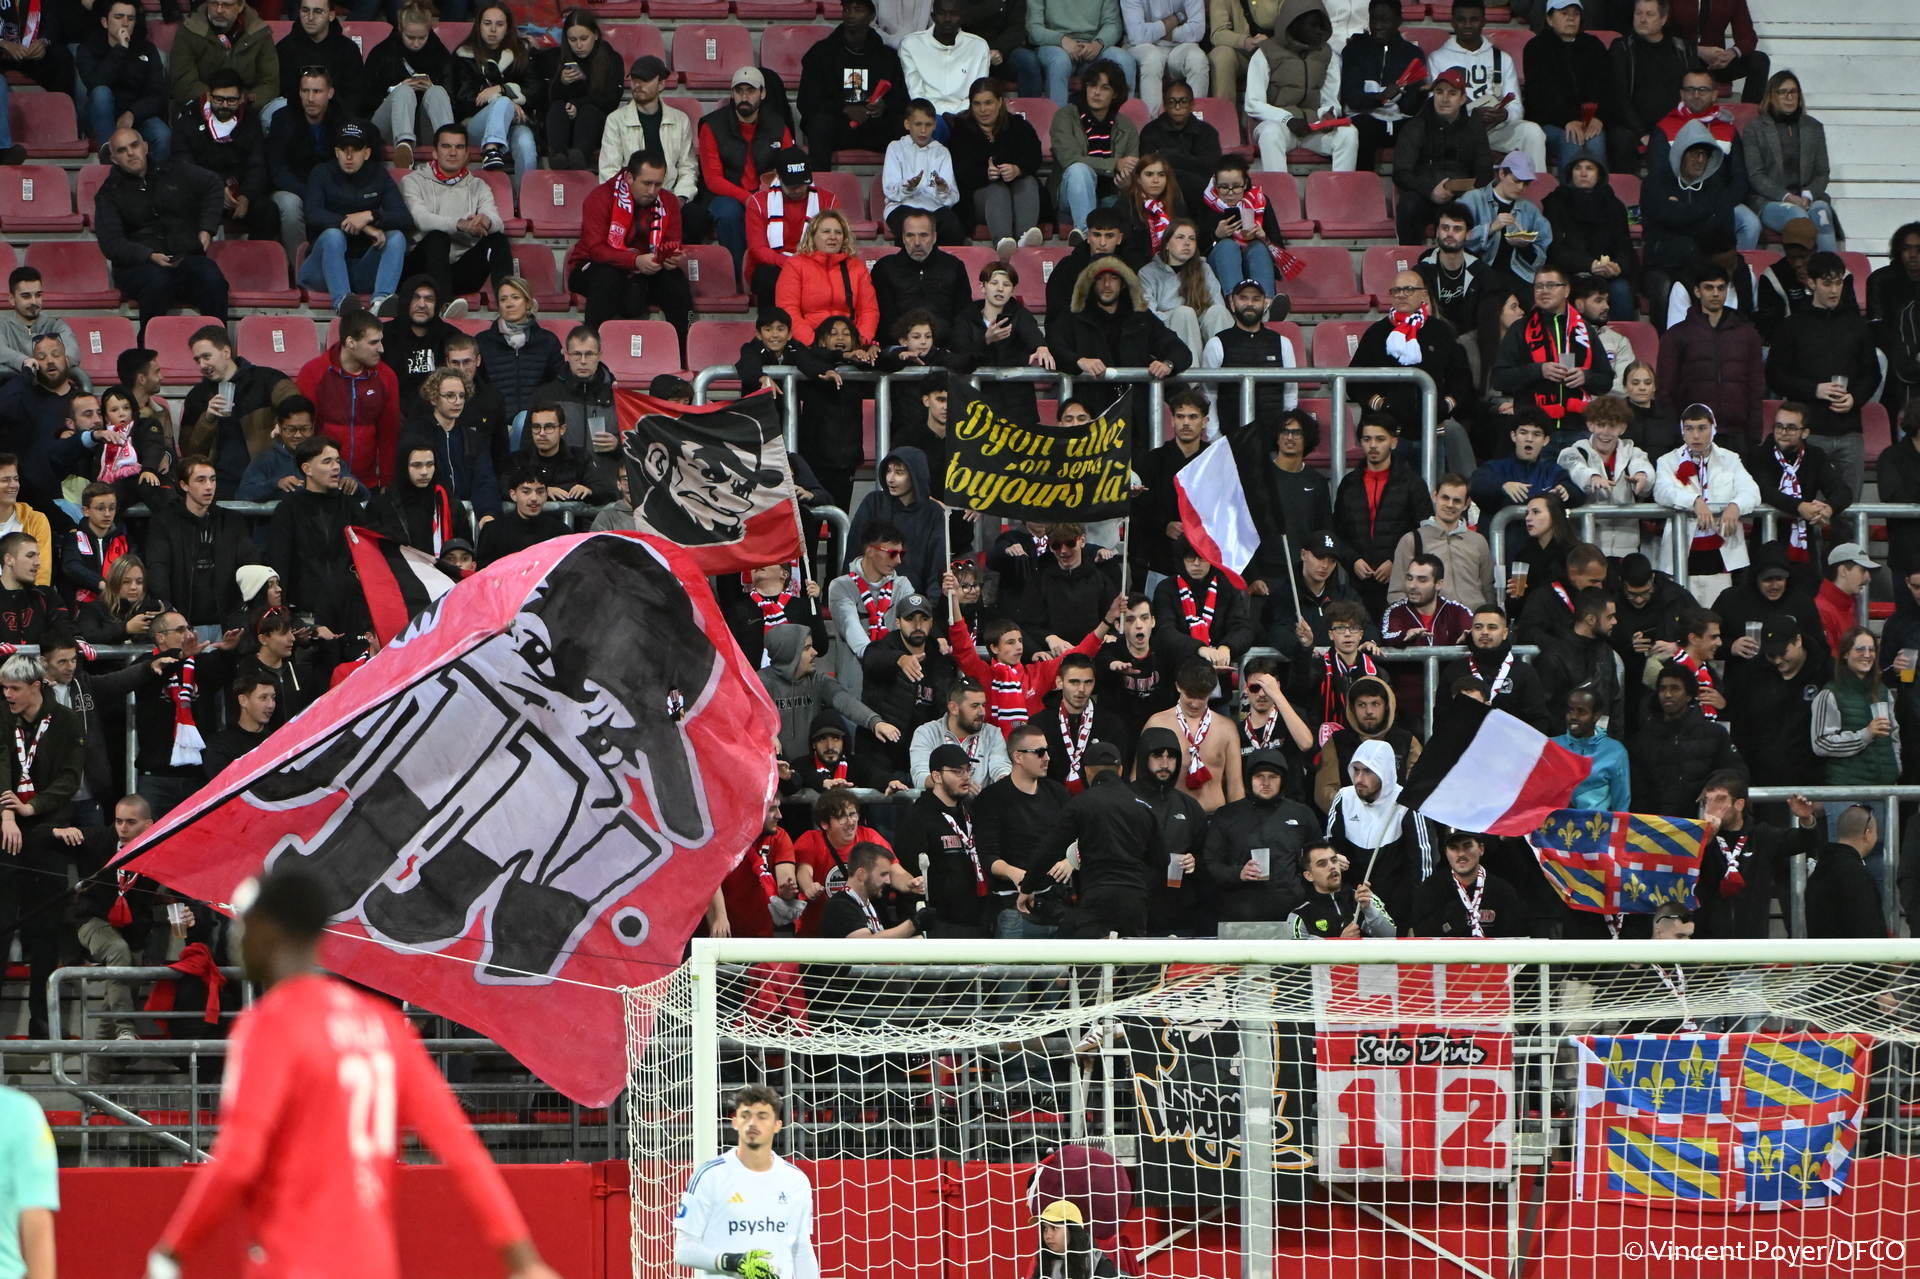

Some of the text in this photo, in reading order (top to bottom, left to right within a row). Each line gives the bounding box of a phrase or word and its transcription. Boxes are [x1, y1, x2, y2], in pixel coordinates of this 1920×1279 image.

[955, 400, 1127, 458] Dijon allez
[945, 452, 1132, 511] toujours là!
[1057, 456, 1103, 480] sera
[1324, 535, 1334, 548] LA
[1353, 1035, 1486, 1064] Solo Divio
[337, 1051, 398, 1160] 21
[728, 1216, 786, 1236] psyshe
